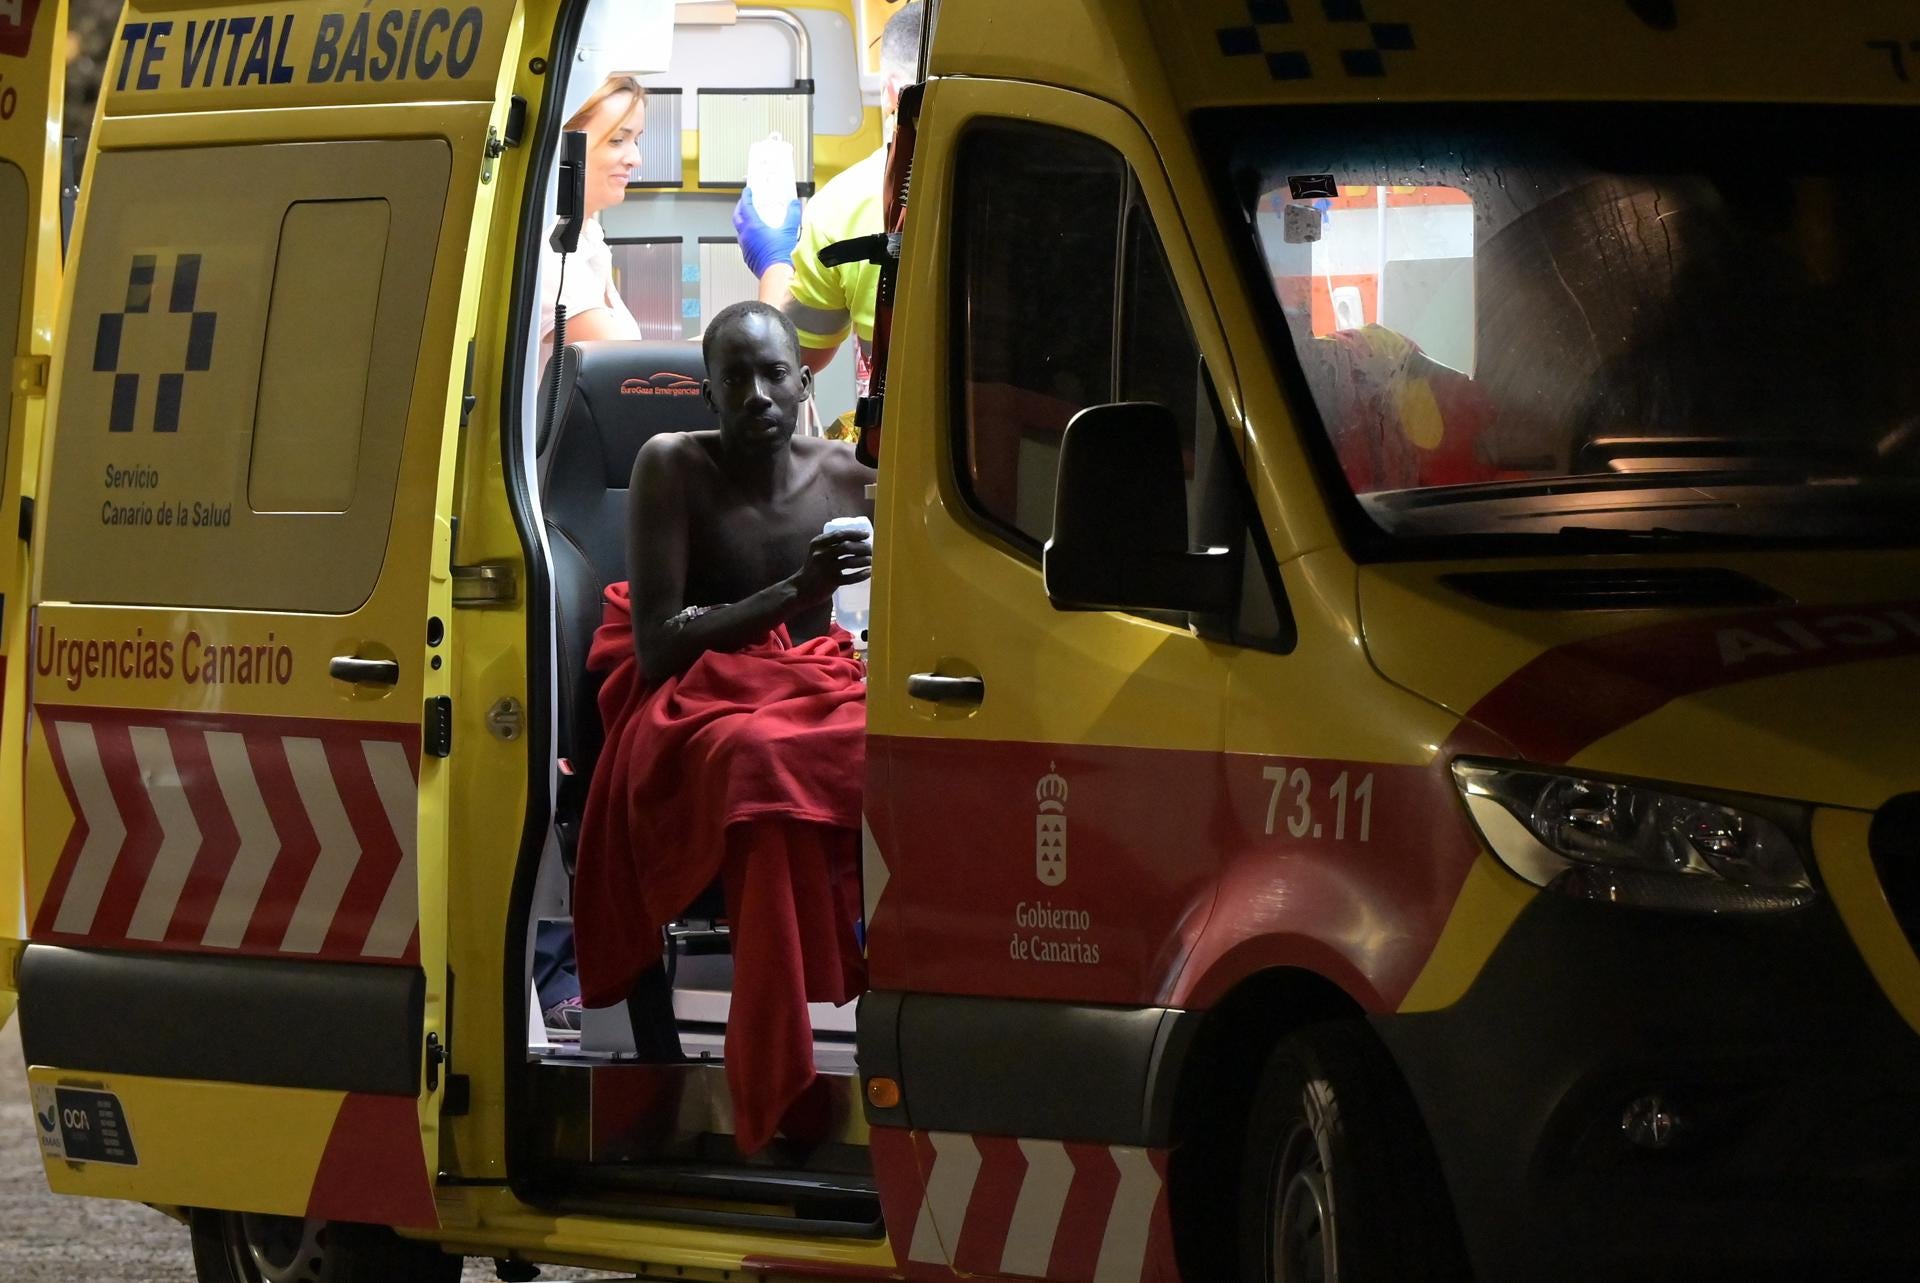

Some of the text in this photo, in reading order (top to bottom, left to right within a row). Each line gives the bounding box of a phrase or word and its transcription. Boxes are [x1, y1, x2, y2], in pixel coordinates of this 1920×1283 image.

[116, 0, 483, 91] TE VITAL BÁSICO
[620, 385, 700, 397] EuroGaza Emergencias
[104, 463, 159, 488] Servicio
[101, 500, 231, 527] Canario de la Salud
[36, 625, 292, 691] Urgencias Canario
[1263, 766, 1374, 842] 73.11
[1016, 901, 1090, 930] Gobierno
[1010, 933, 1100, 964] de Canarias
[64, 1108, 90, 1130] OCA
